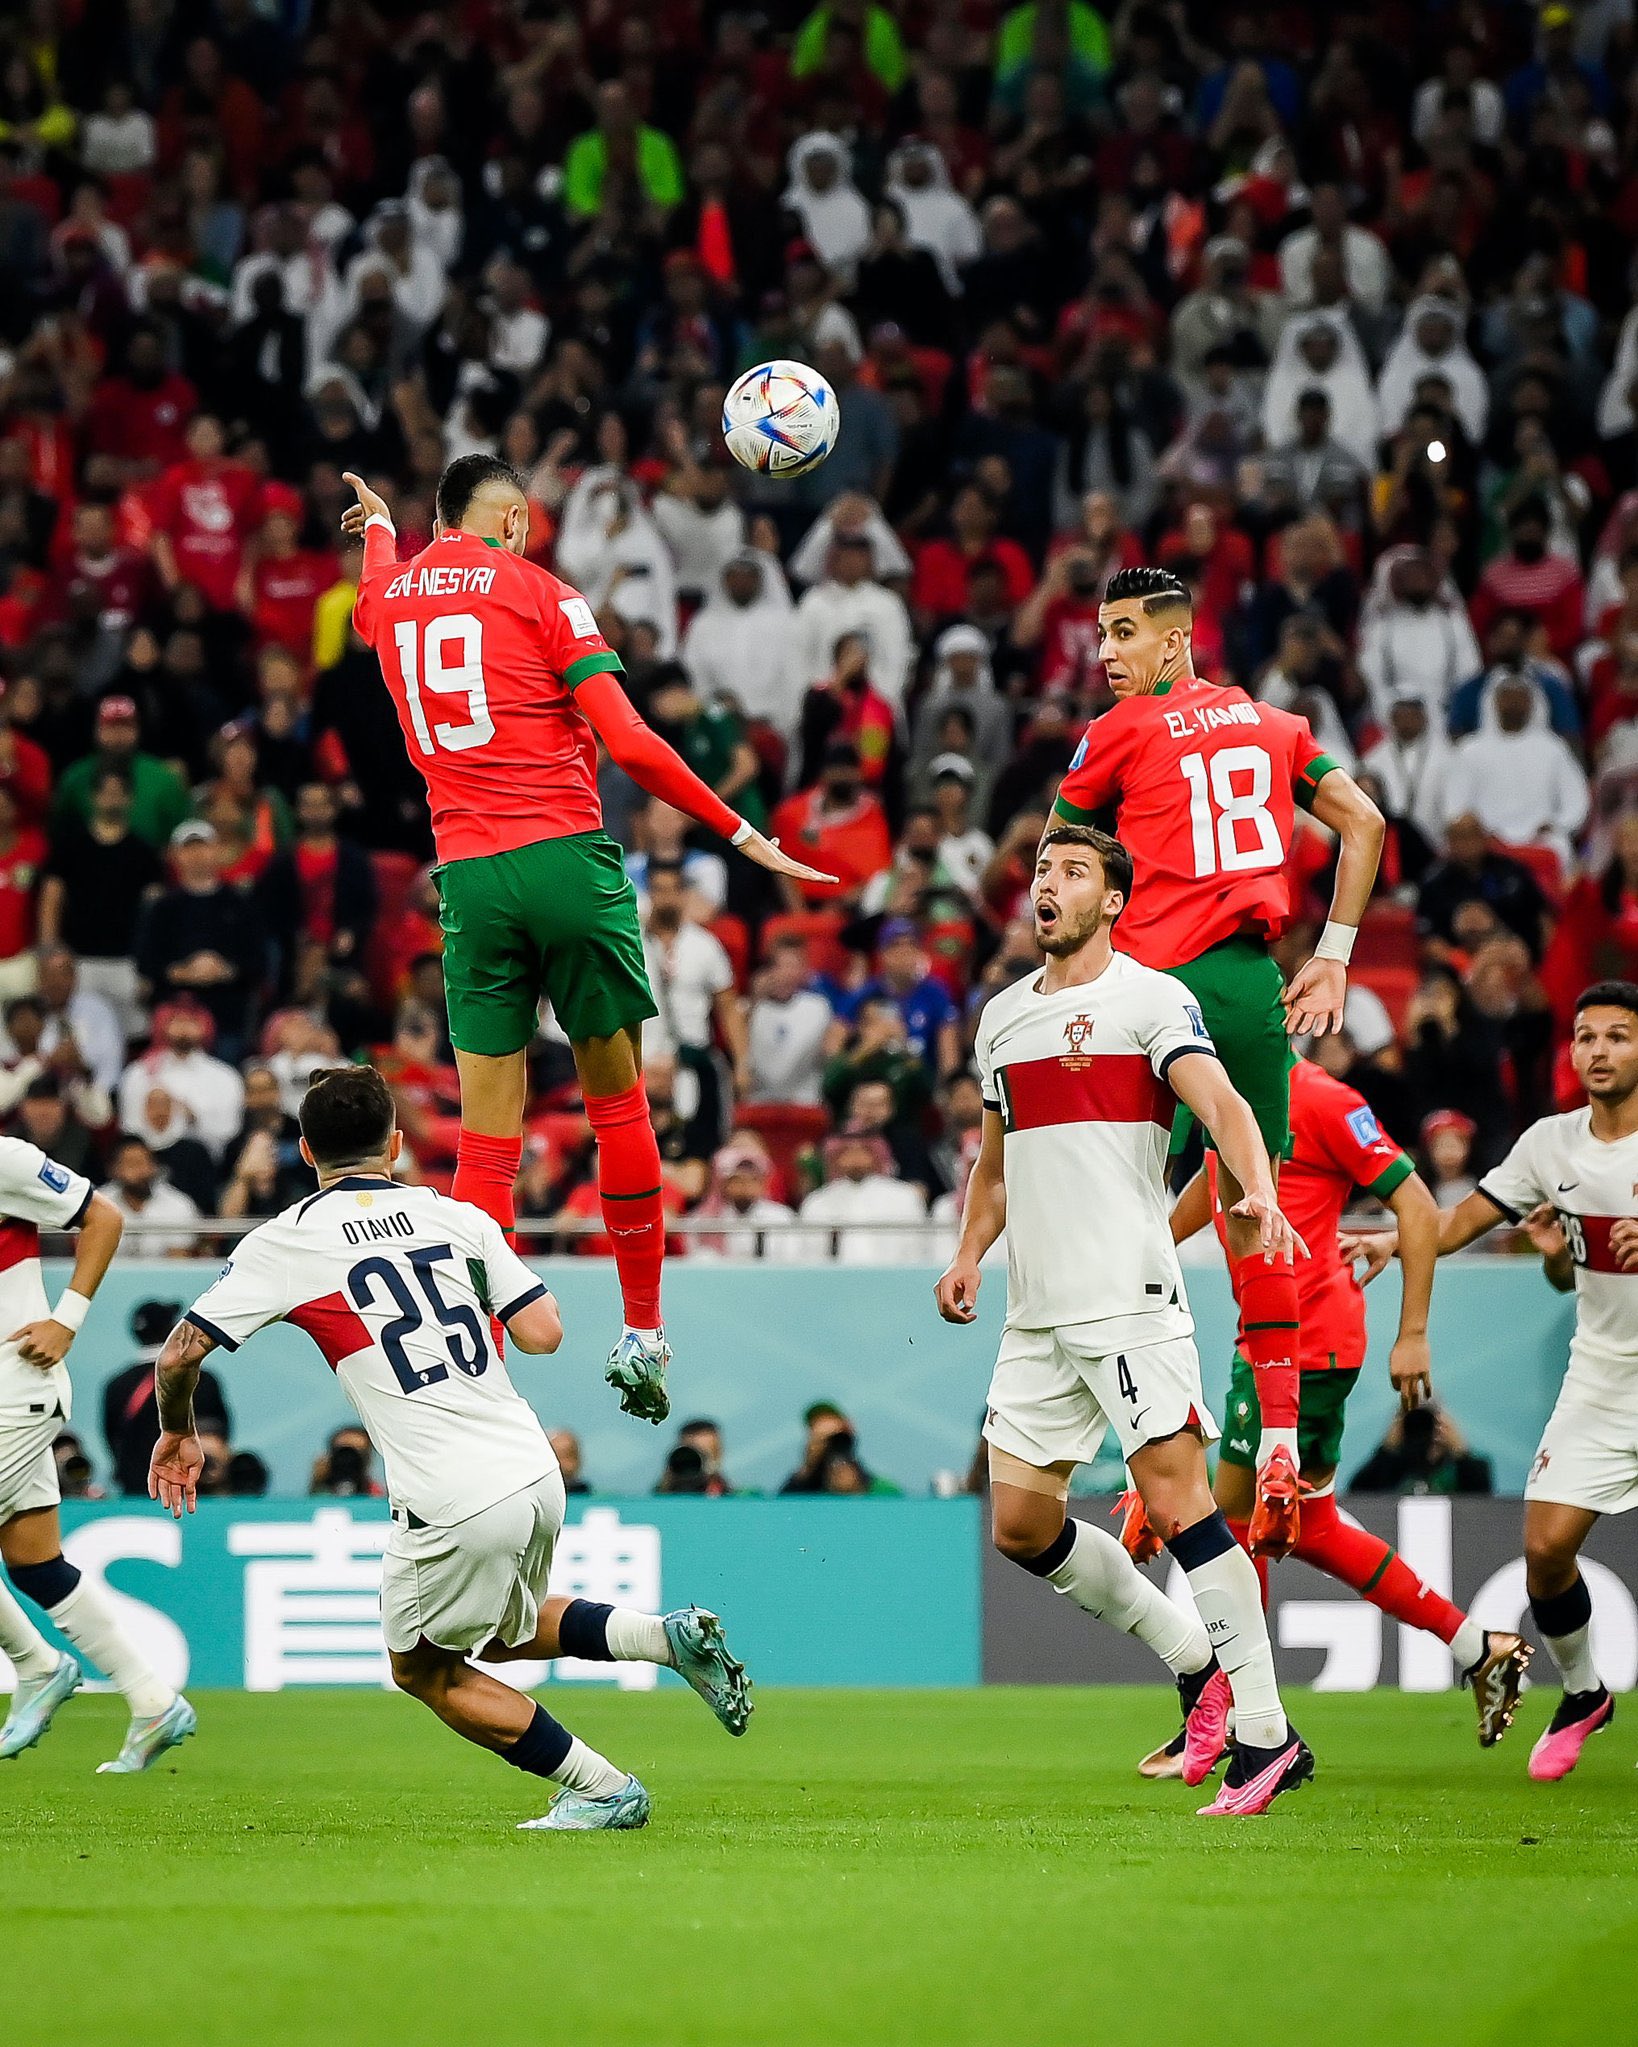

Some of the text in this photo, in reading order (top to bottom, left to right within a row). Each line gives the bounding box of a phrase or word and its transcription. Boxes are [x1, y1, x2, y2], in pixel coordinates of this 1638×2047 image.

[383, 566, 497, 599] EN-NESYRI
[393, 613, 497, 756] 19
[1179, 744, 1285, 878] 18
[341, 1210, 415, 1245] OTÁVIO
[347, 1243, 489, 1395] 25
[1117, 1353, 1139, 1405] 4
